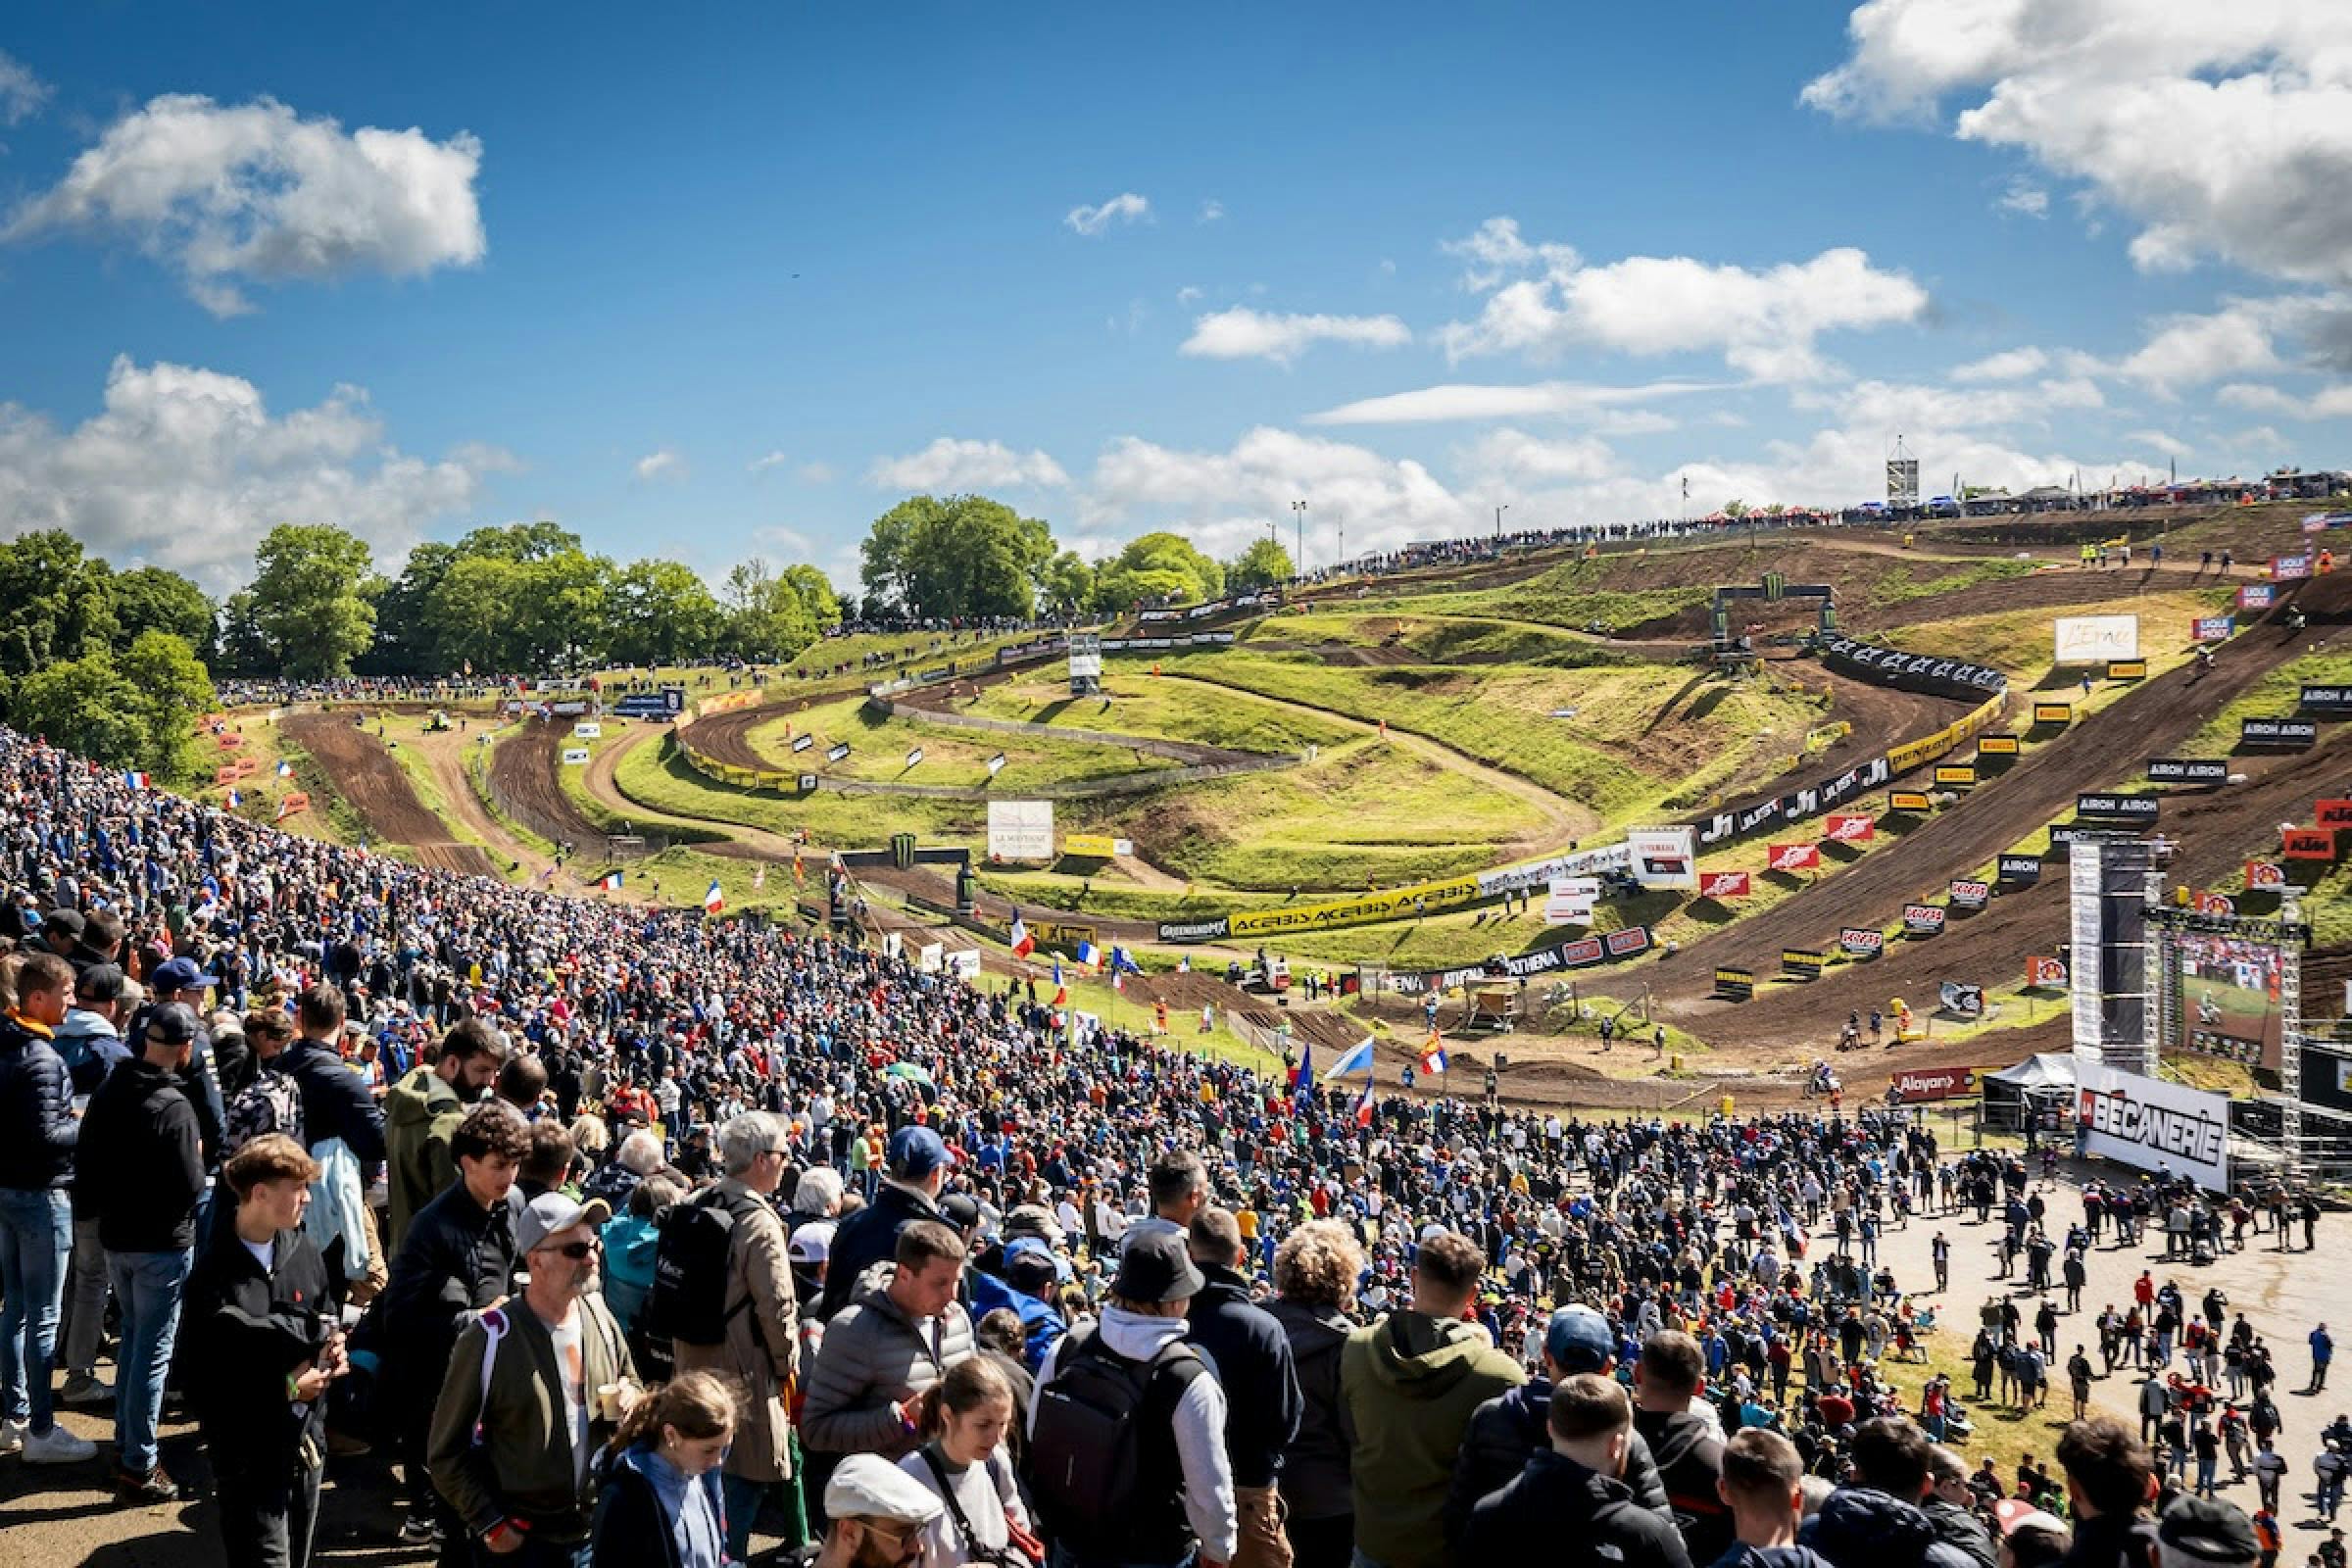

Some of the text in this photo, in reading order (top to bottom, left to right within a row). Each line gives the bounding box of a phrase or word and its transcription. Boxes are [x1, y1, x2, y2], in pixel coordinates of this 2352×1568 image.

[2303, 689, 2340, 701] AIROH
[2244, 723, 2315, 735] AIROH AIROH
[2149, 763, 2225, 777] AIROH AIROH
[2080, 799, 2157, 811] AIROH AIROH
[2289, 836, 2329, 852] KTM
[2001, 859, 2039, 871] AIROH
[1396, 884, 1478, 907] ACERBIS
[1314, 901, 1392, 919] ACERBIS
[1236, 912, 1312, 931] ACERBIS
[1508, 949, 1560, 976] ATHENA
